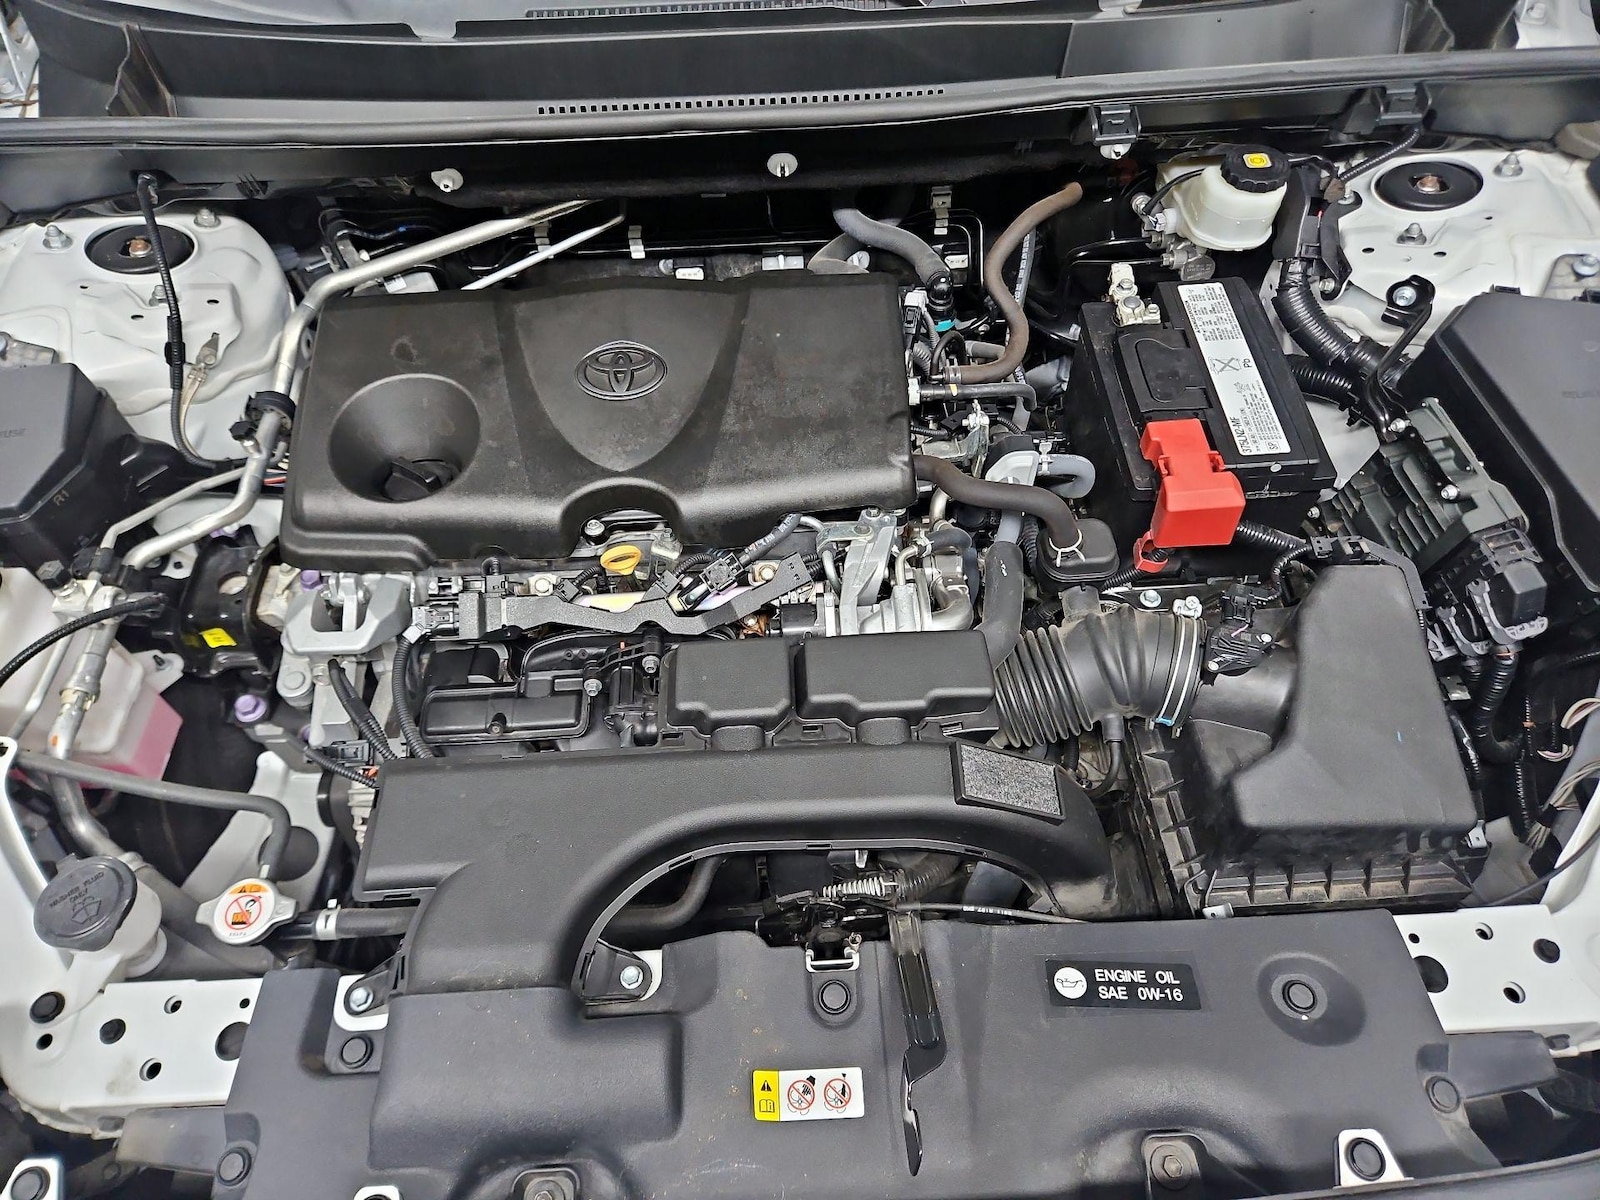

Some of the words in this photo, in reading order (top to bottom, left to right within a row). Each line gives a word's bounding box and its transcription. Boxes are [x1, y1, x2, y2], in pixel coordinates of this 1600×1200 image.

[1242, 358, 1253, 368] Pb
[1230, 416, 1252, 453] 375LN2-MF
[53, 489, 70, 506] R1
[49, 886, 80, 909] WASHER
[83, 871, 104, 887] FLUID
[69, 888, 88, 903] ONLY
[1094, 968, 1148, 984] ENGINE
[1155, 970, 1181, 985] OIL
[1098, 986, 1129, 1000] SAE
[1137, 987, 1184, 1001] 0W-16
